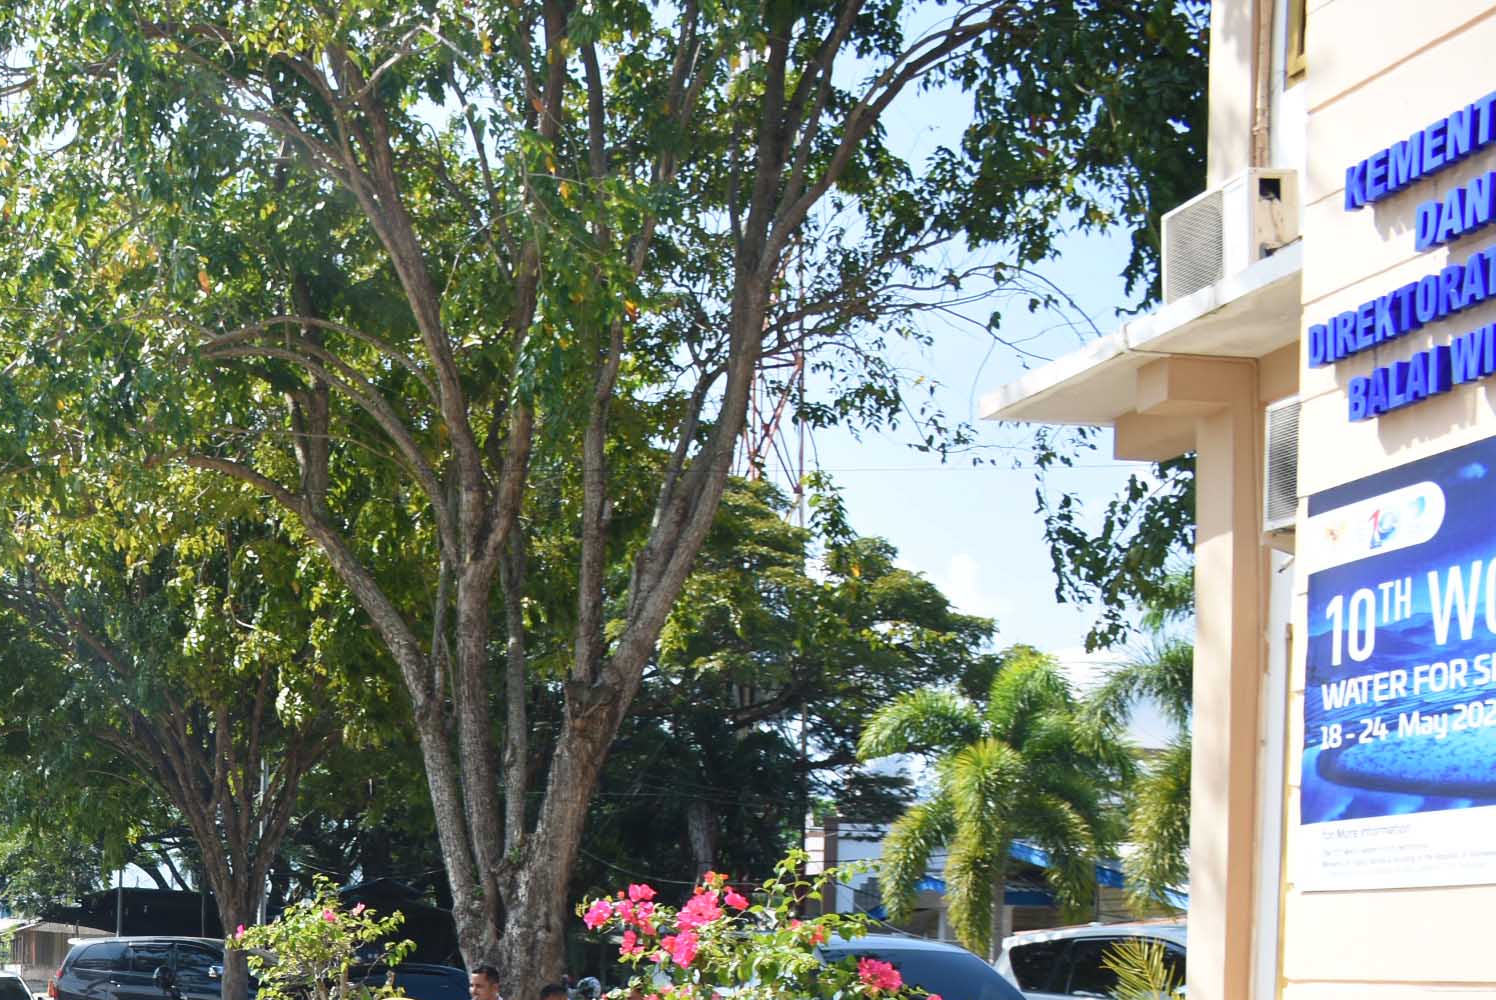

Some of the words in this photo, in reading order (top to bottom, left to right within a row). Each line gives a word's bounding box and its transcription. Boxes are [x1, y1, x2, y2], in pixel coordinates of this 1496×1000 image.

[1345, 90, 1496, 212] KEMENT
[1415, 171, 1496, 252] DAN
[1308, 244, 1496, 369] DIREKTORAT
[1348, 345, 1452, 422] BALAI
[1321, 669, 1408, 711] WATER
[1413, 658, 1469, 695] FOR
[1474, 650, 1496, 686] S
[1398, 710, 1449, 740] May
